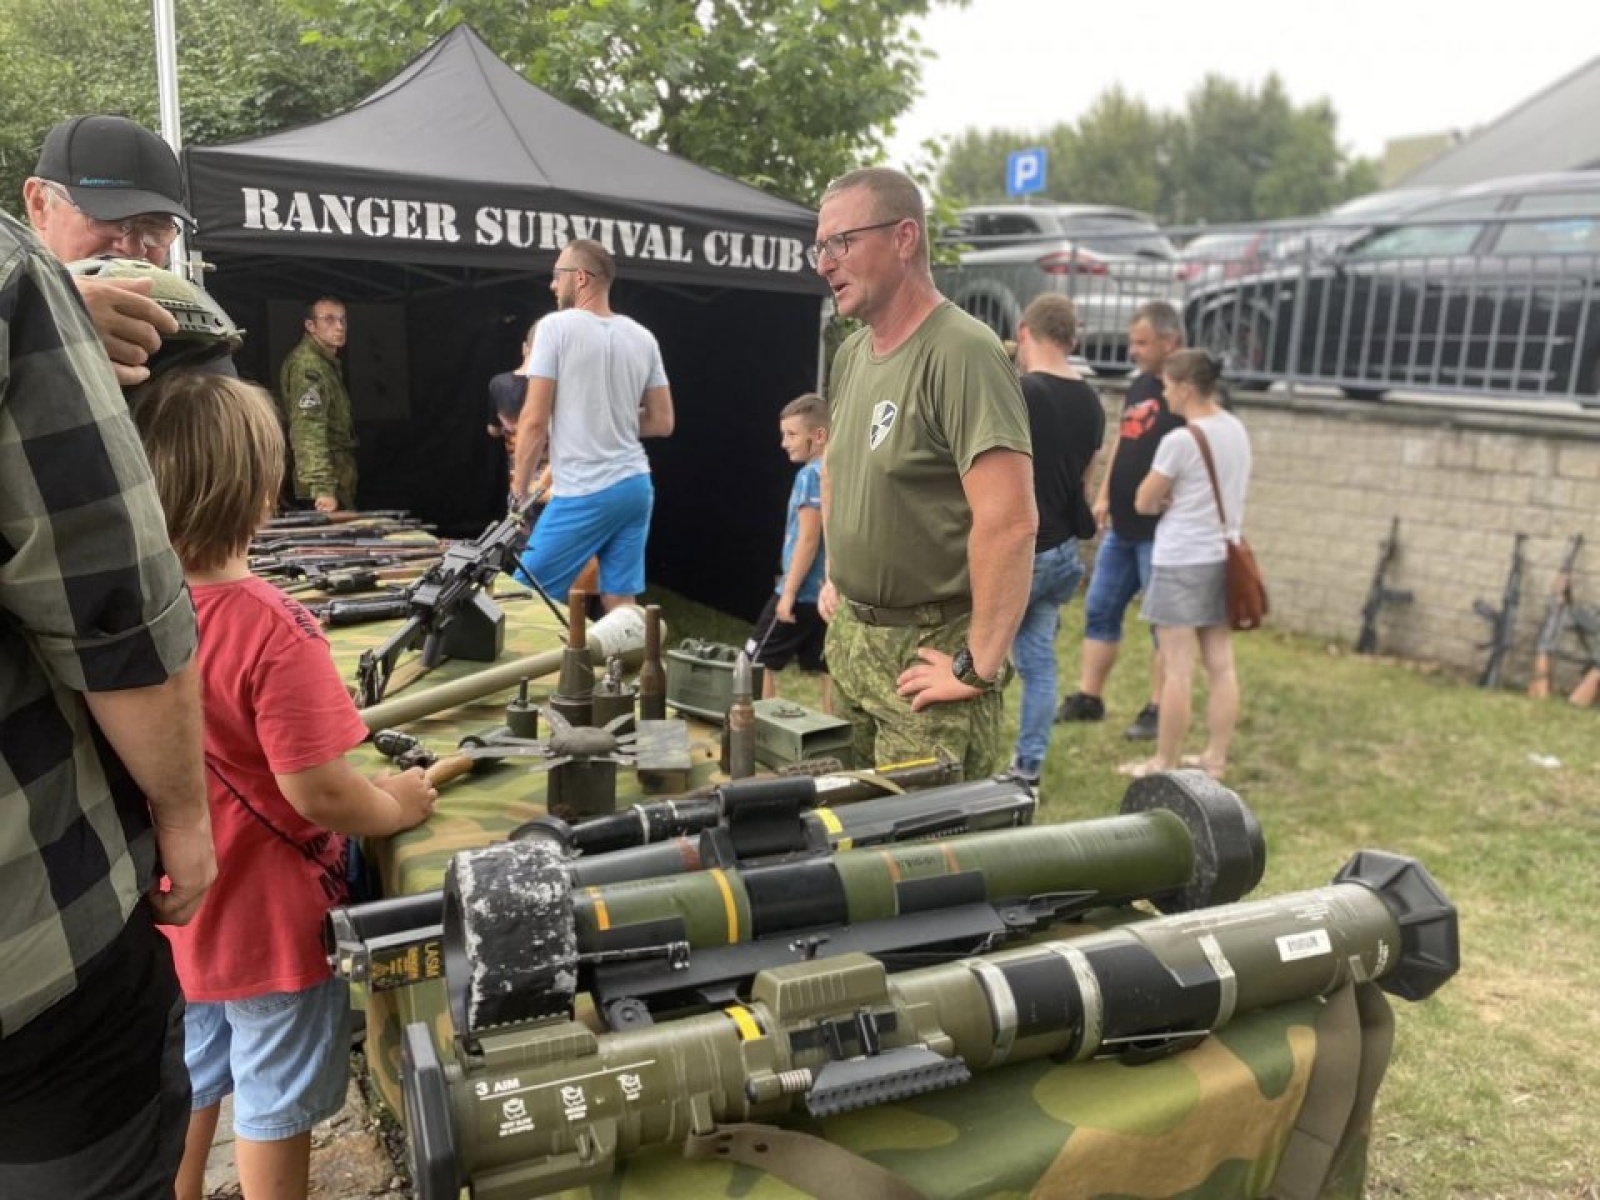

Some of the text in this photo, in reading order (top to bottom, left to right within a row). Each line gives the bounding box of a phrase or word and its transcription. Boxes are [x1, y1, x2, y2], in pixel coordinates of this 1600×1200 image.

[1014, 155, 1038, 191] P
[241, 187, 803, 272] RANGER SURVIVAL CLUB
[475, 1078, 521, 1096] 3 AIM
